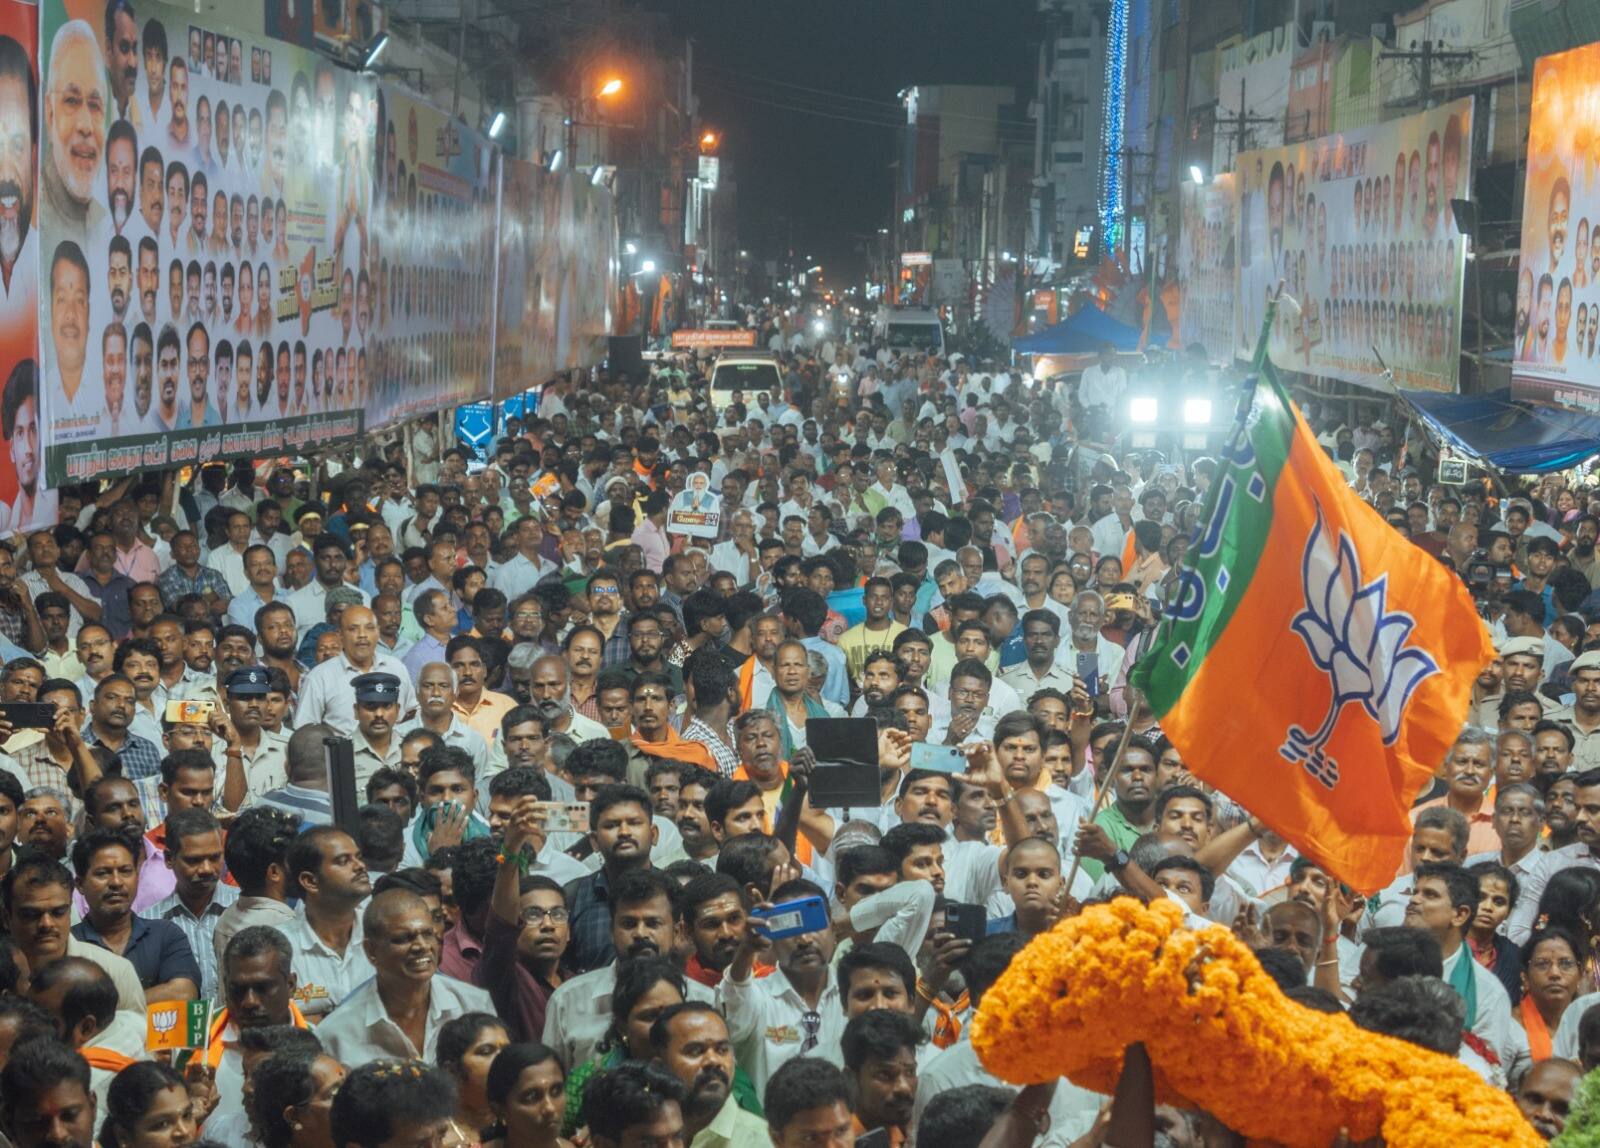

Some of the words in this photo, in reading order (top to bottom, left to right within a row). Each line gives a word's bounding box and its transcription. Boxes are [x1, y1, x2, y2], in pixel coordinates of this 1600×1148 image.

[66, 443, 107, 482] பாரதிய
[108, 445, 143, 475] ஜனதா
[143, 435, 168, 466] கட்சி
[193, 1003, 204, 1045] BJP
